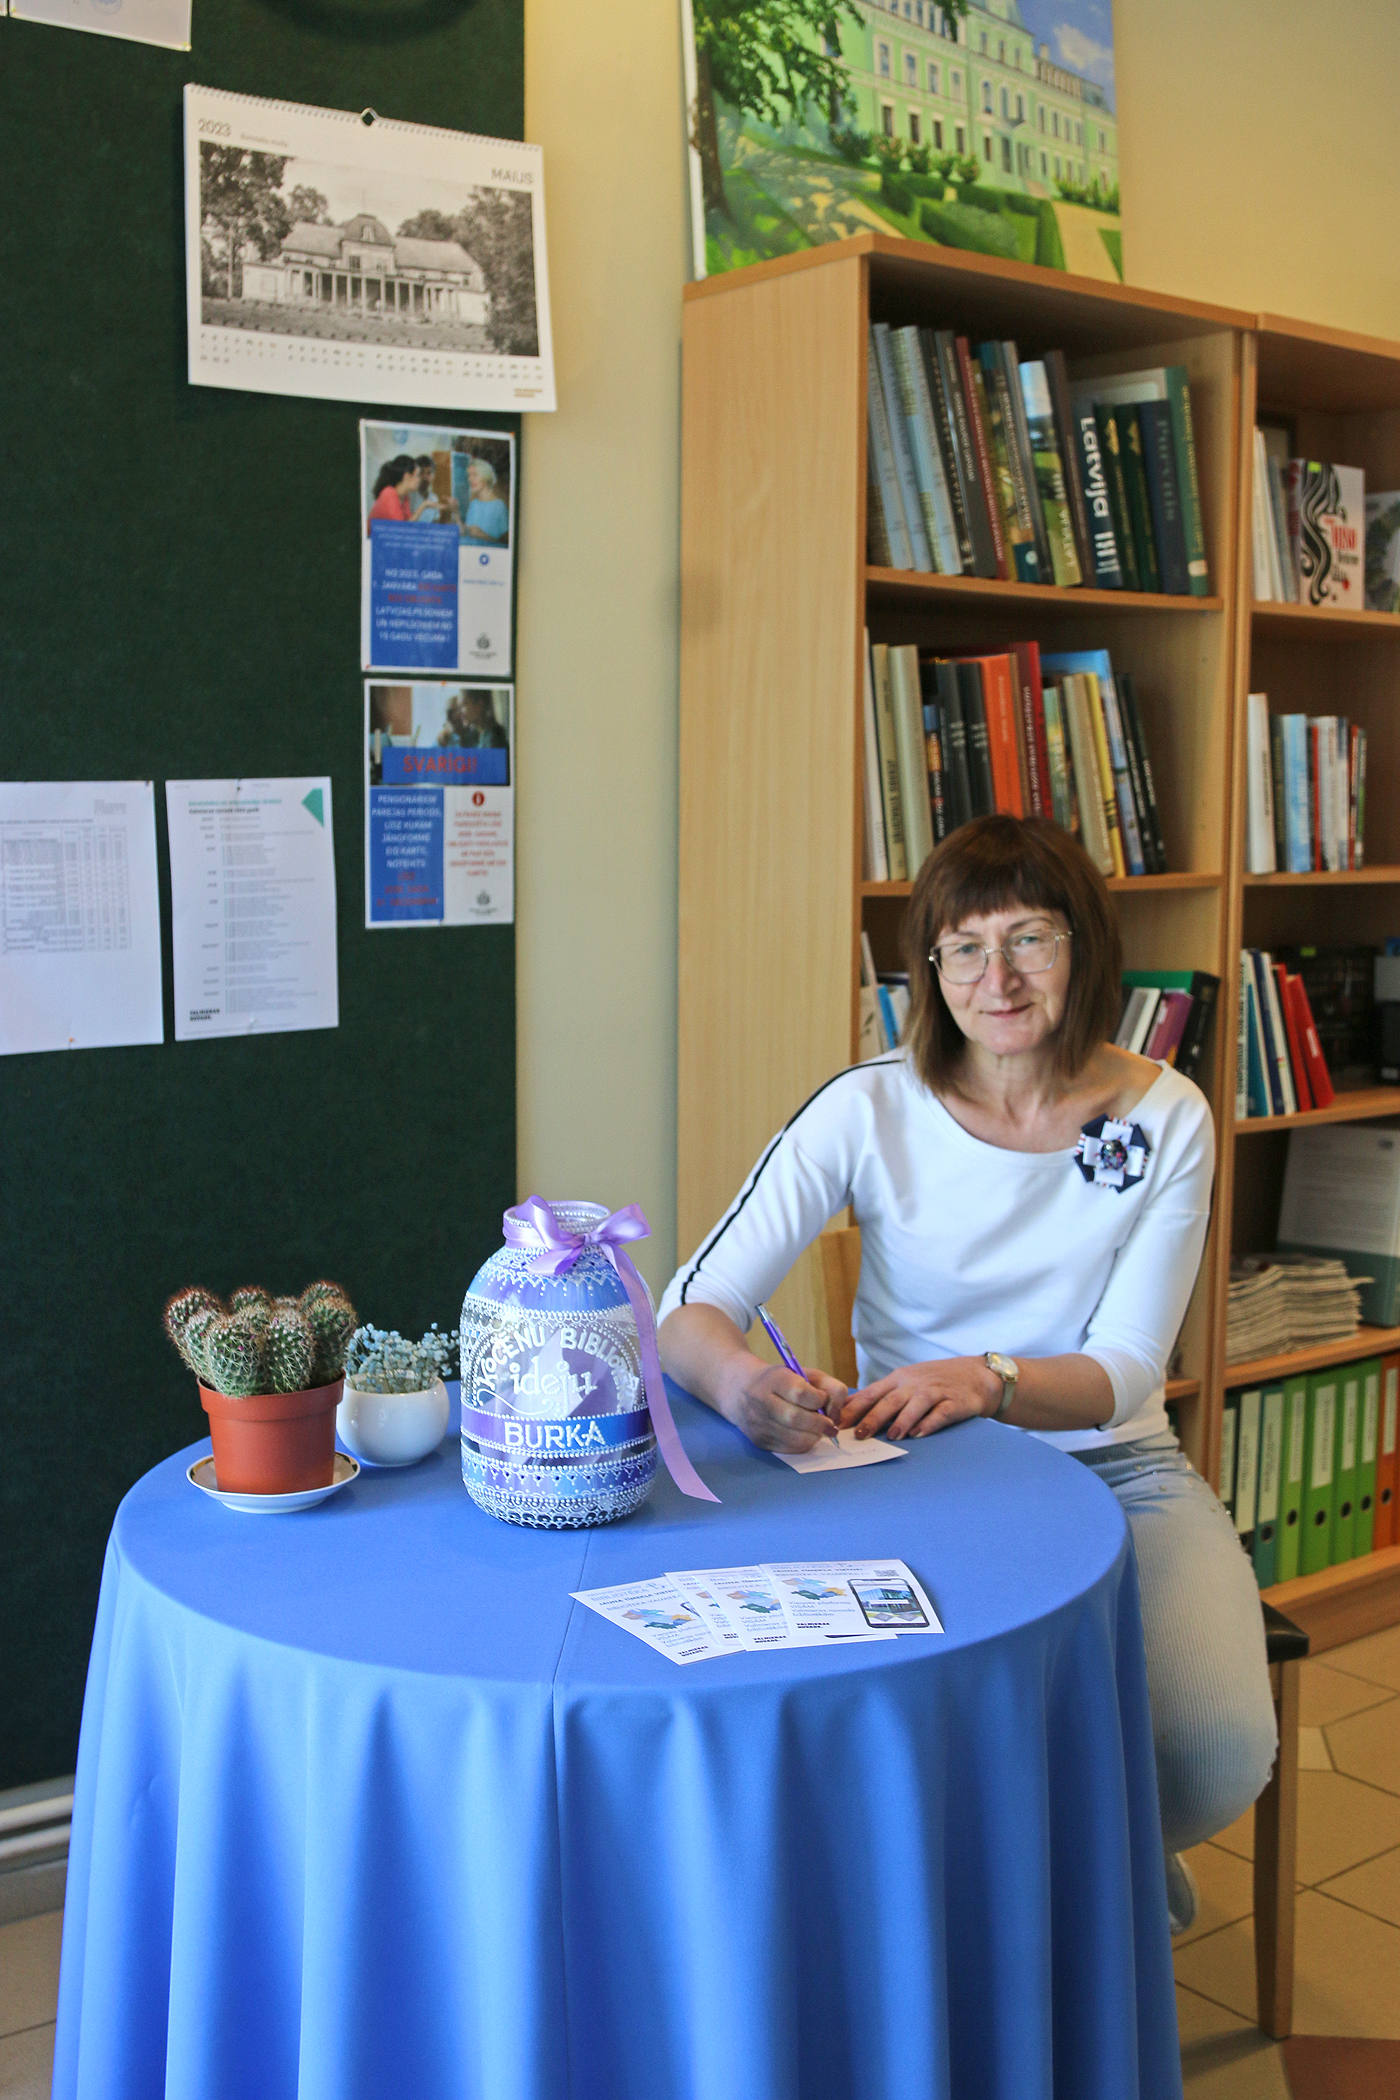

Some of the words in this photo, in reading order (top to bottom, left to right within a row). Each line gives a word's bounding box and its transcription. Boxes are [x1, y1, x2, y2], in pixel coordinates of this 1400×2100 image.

[198, 118, 231, 137] 2023
[1080, 417, 1109, 518] Latvija
[476, 1326, 545, 1391] KOCĒNU
[504, 1420, 606, 1449] BURKA
